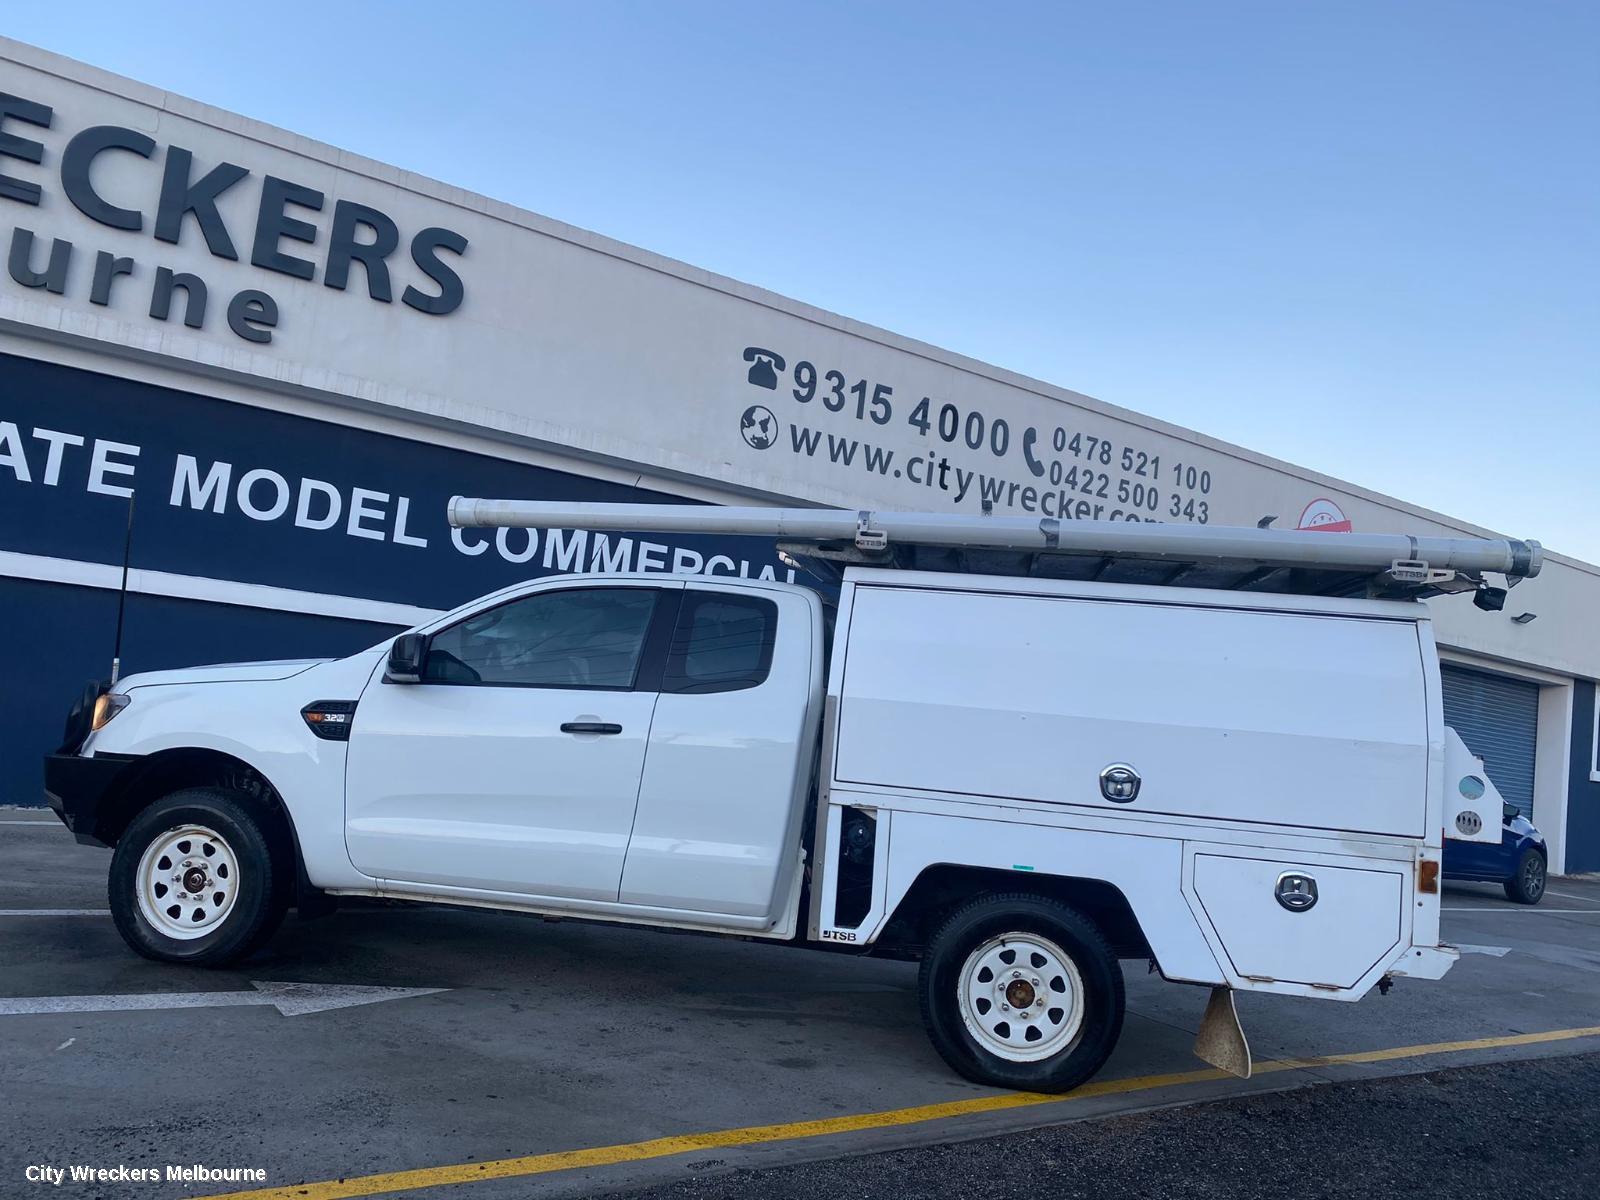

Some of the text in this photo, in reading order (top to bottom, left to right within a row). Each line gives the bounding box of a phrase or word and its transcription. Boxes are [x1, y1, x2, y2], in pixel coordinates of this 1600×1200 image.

[0, 92, 469, 315] ECKERS
[8, 227, 279, 343] urne
[793, 361, 1009, 457] 9315 4000
[0, 421, 141, 499] ATE
[169, 454, 428, 548] MODEL
[790, 424, 1164, 523] www.citywrecker
[1050, 460, 1209, 524] 0422 500 343
[1053, 427, 1211, 494] 0478 521 100
